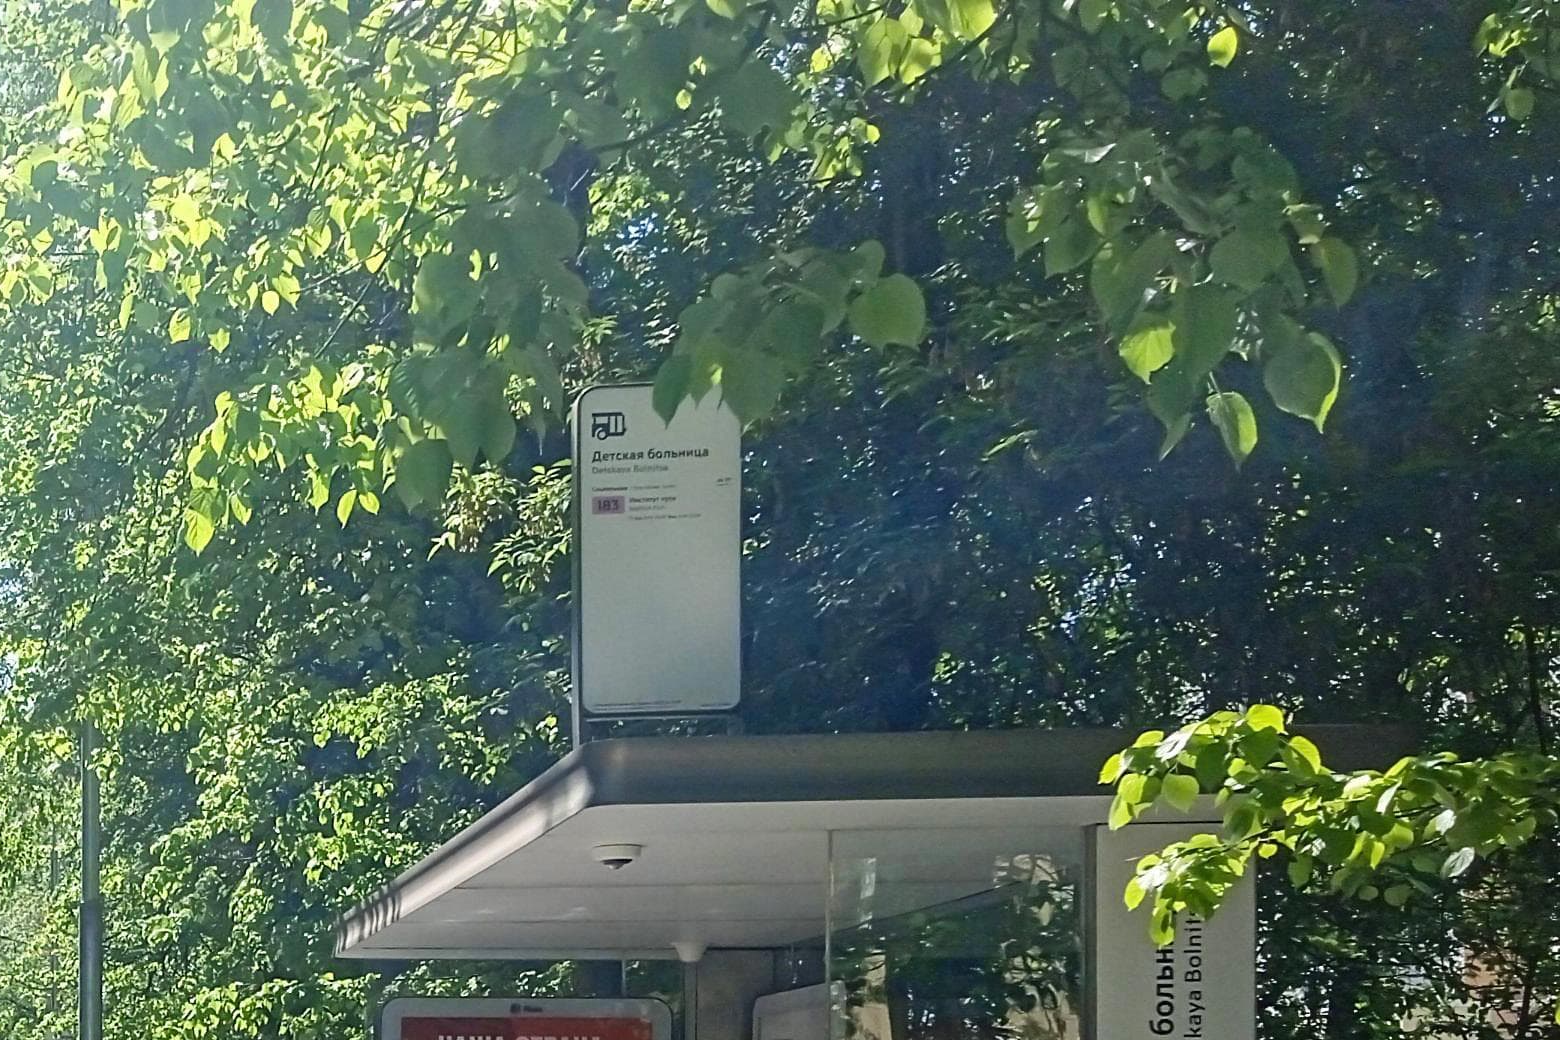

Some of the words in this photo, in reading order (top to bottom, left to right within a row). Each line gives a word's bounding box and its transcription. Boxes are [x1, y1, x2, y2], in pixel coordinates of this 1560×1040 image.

[592, 450, 644, 463] Детская
[647, 448, 709, 460] больница
[597, 499, 619, 511] 183
[1149, 910, 1176, 1035] больн
